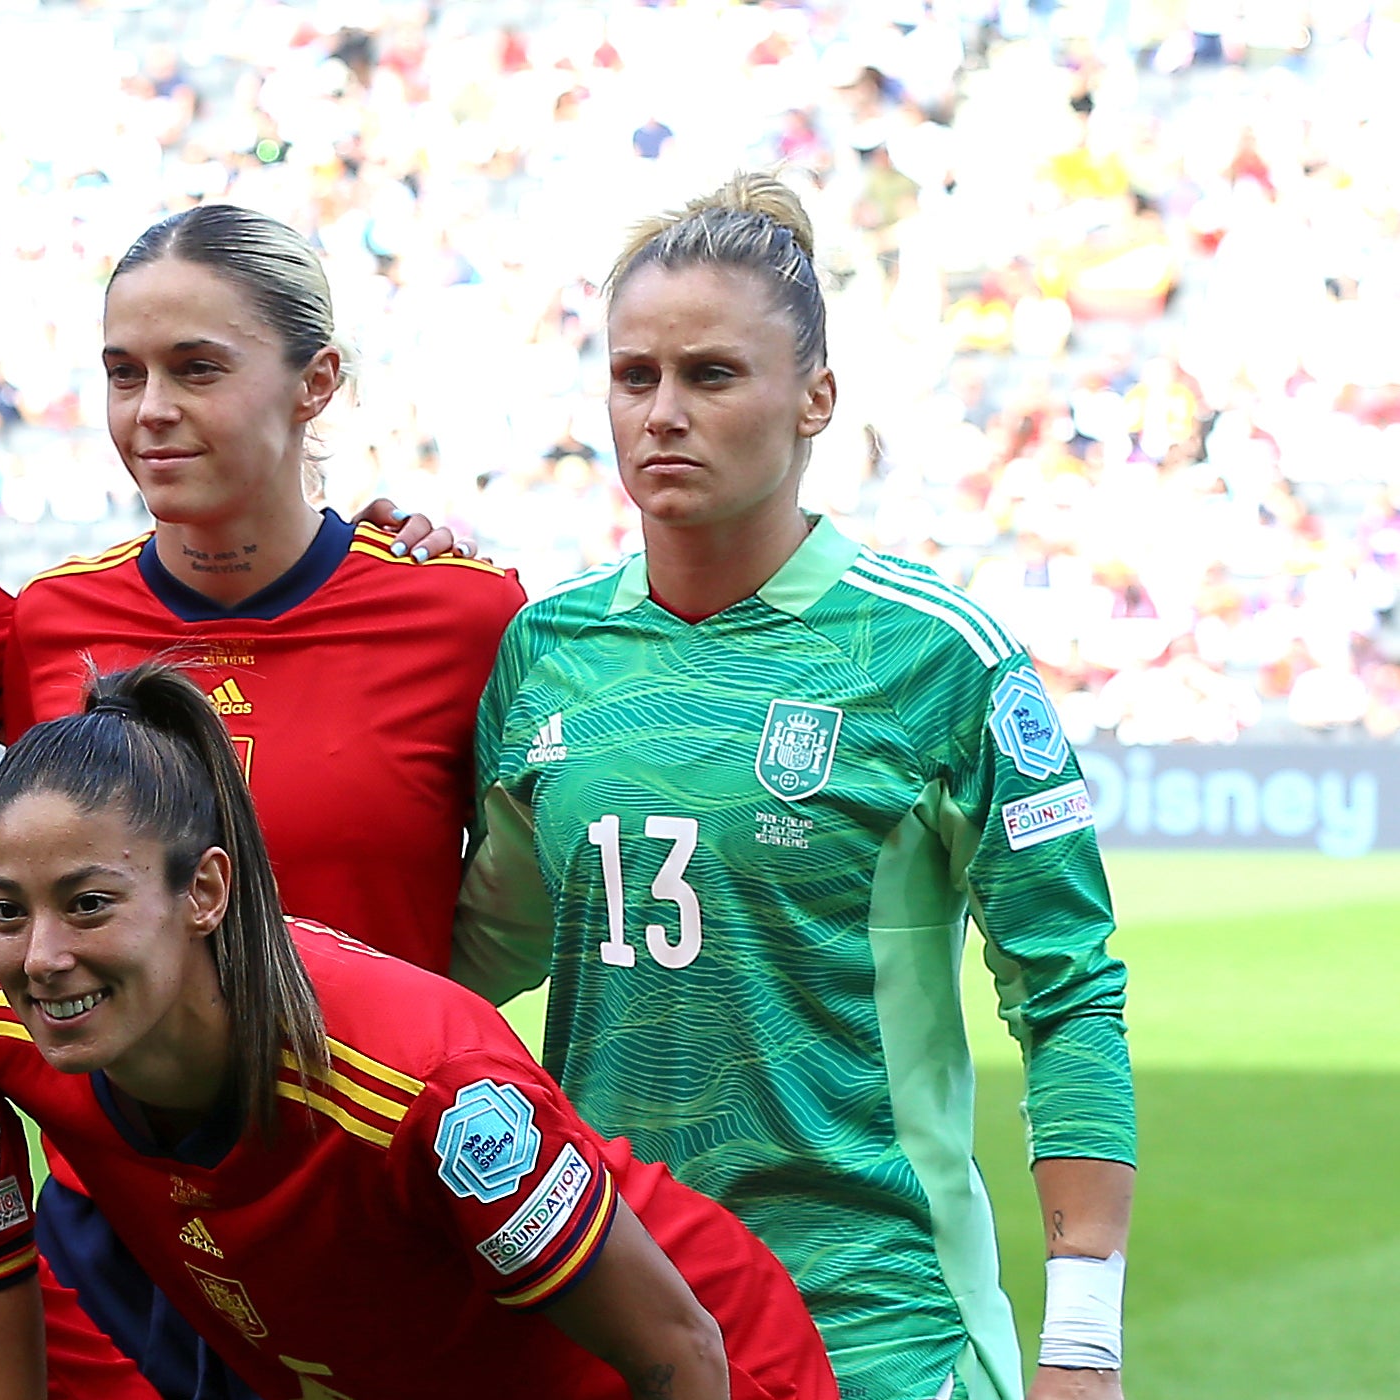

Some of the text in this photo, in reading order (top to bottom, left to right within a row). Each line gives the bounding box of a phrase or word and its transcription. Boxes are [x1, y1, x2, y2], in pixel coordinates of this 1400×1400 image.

[589, 815, 702, 969] 13
[479, 1131, 515, 1169] Strong
[488, 1155, 583, 1264] FOUNDATION
[179, 1233, 224, 1259] adidas
[482, 1230, 511, 1253] UEFA
